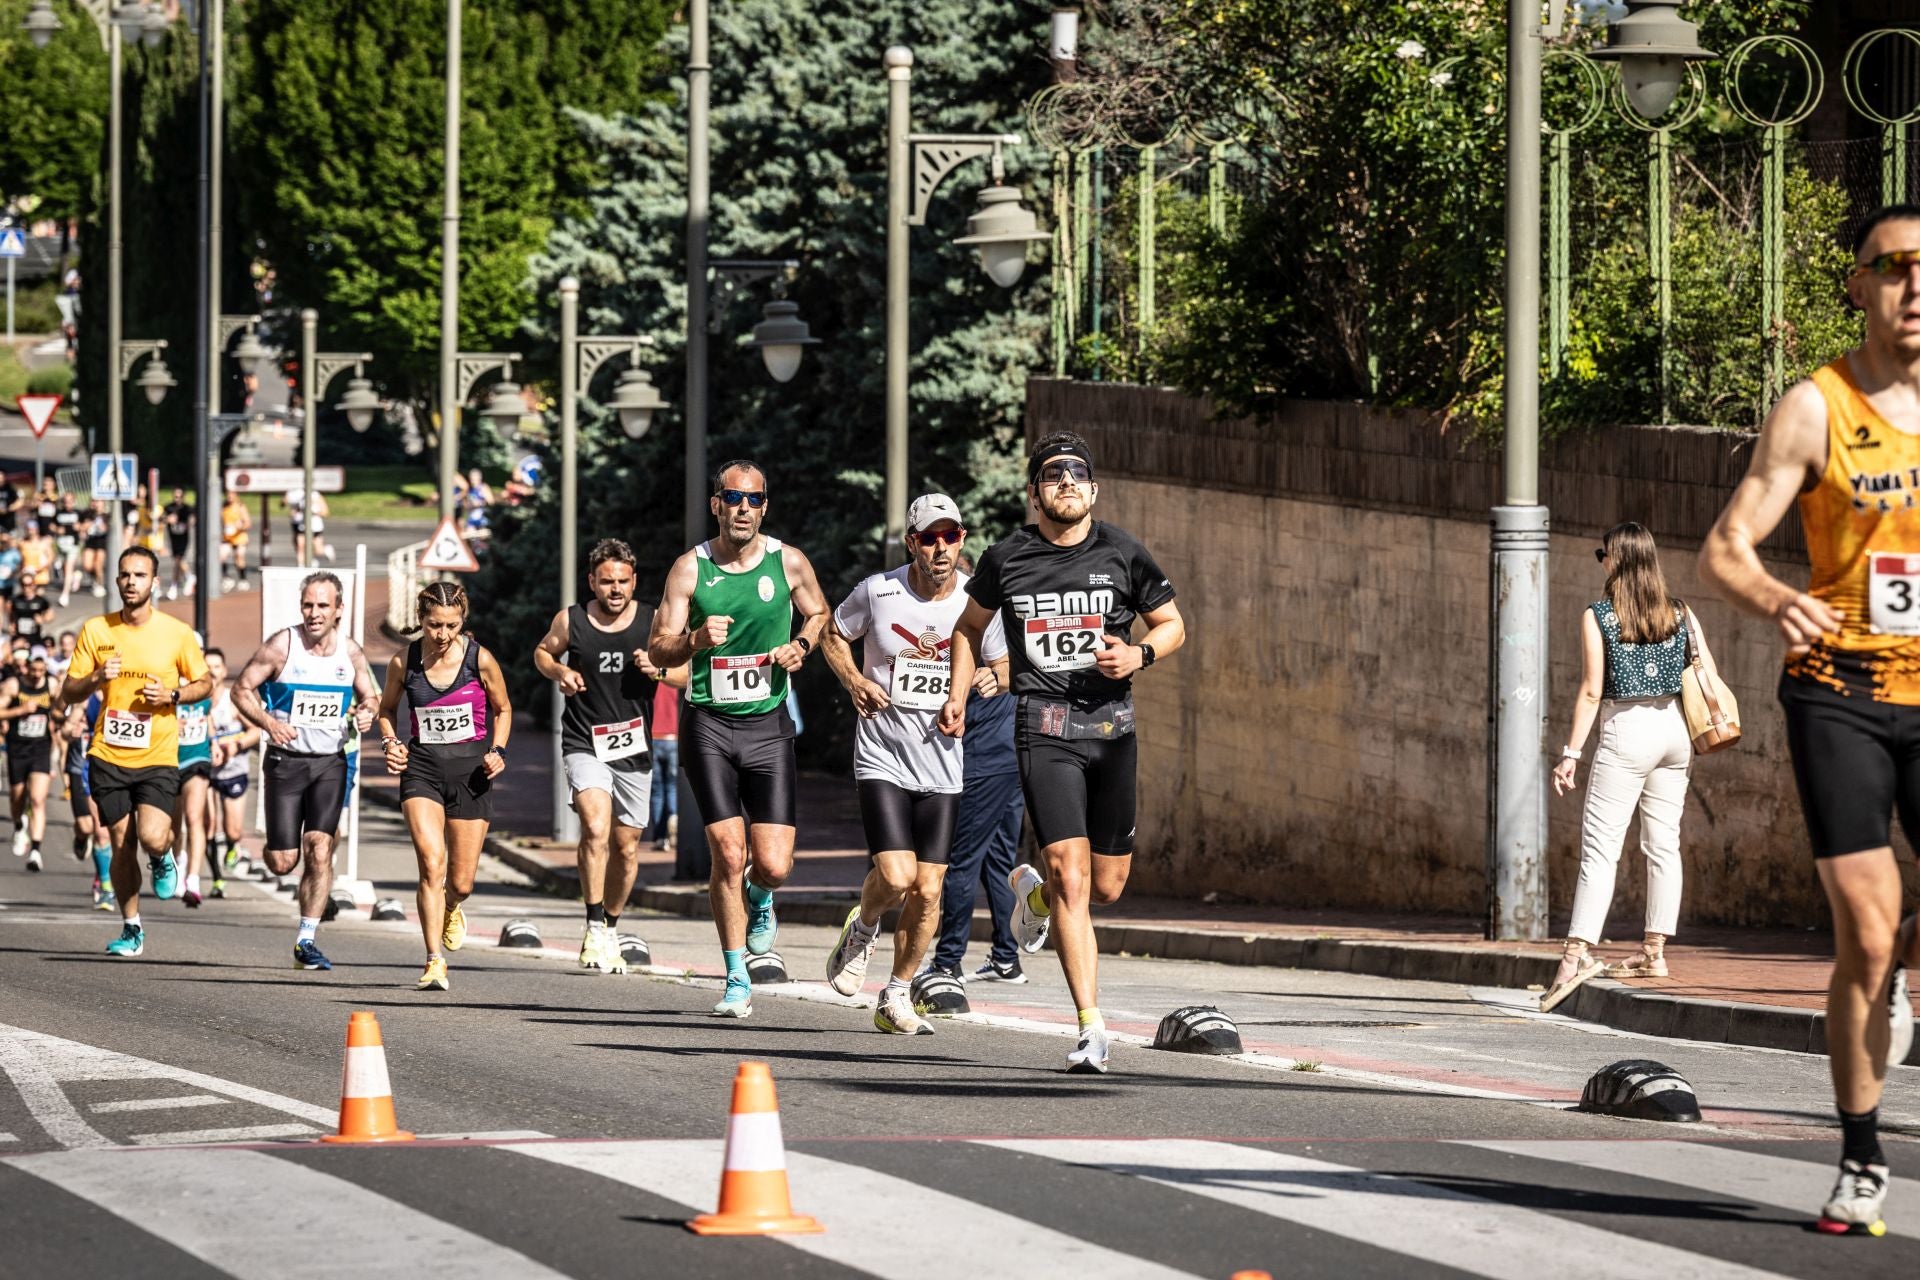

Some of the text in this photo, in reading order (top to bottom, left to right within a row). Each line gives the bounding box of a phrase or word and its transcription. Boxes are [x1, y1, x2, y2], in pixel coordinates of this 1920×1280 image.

[1036, 631, 1097, 657] 162
[599, 652, 624, 673] 23
[907, 662, 944, 671] CARRERA
[727, 669, 760, 690] 10
[297, 702, 339, 717] 1122
[109, 720, 145, 738] 328
[423, 714, 470, 732] 1325
[607, 732, 633, 750] 23
